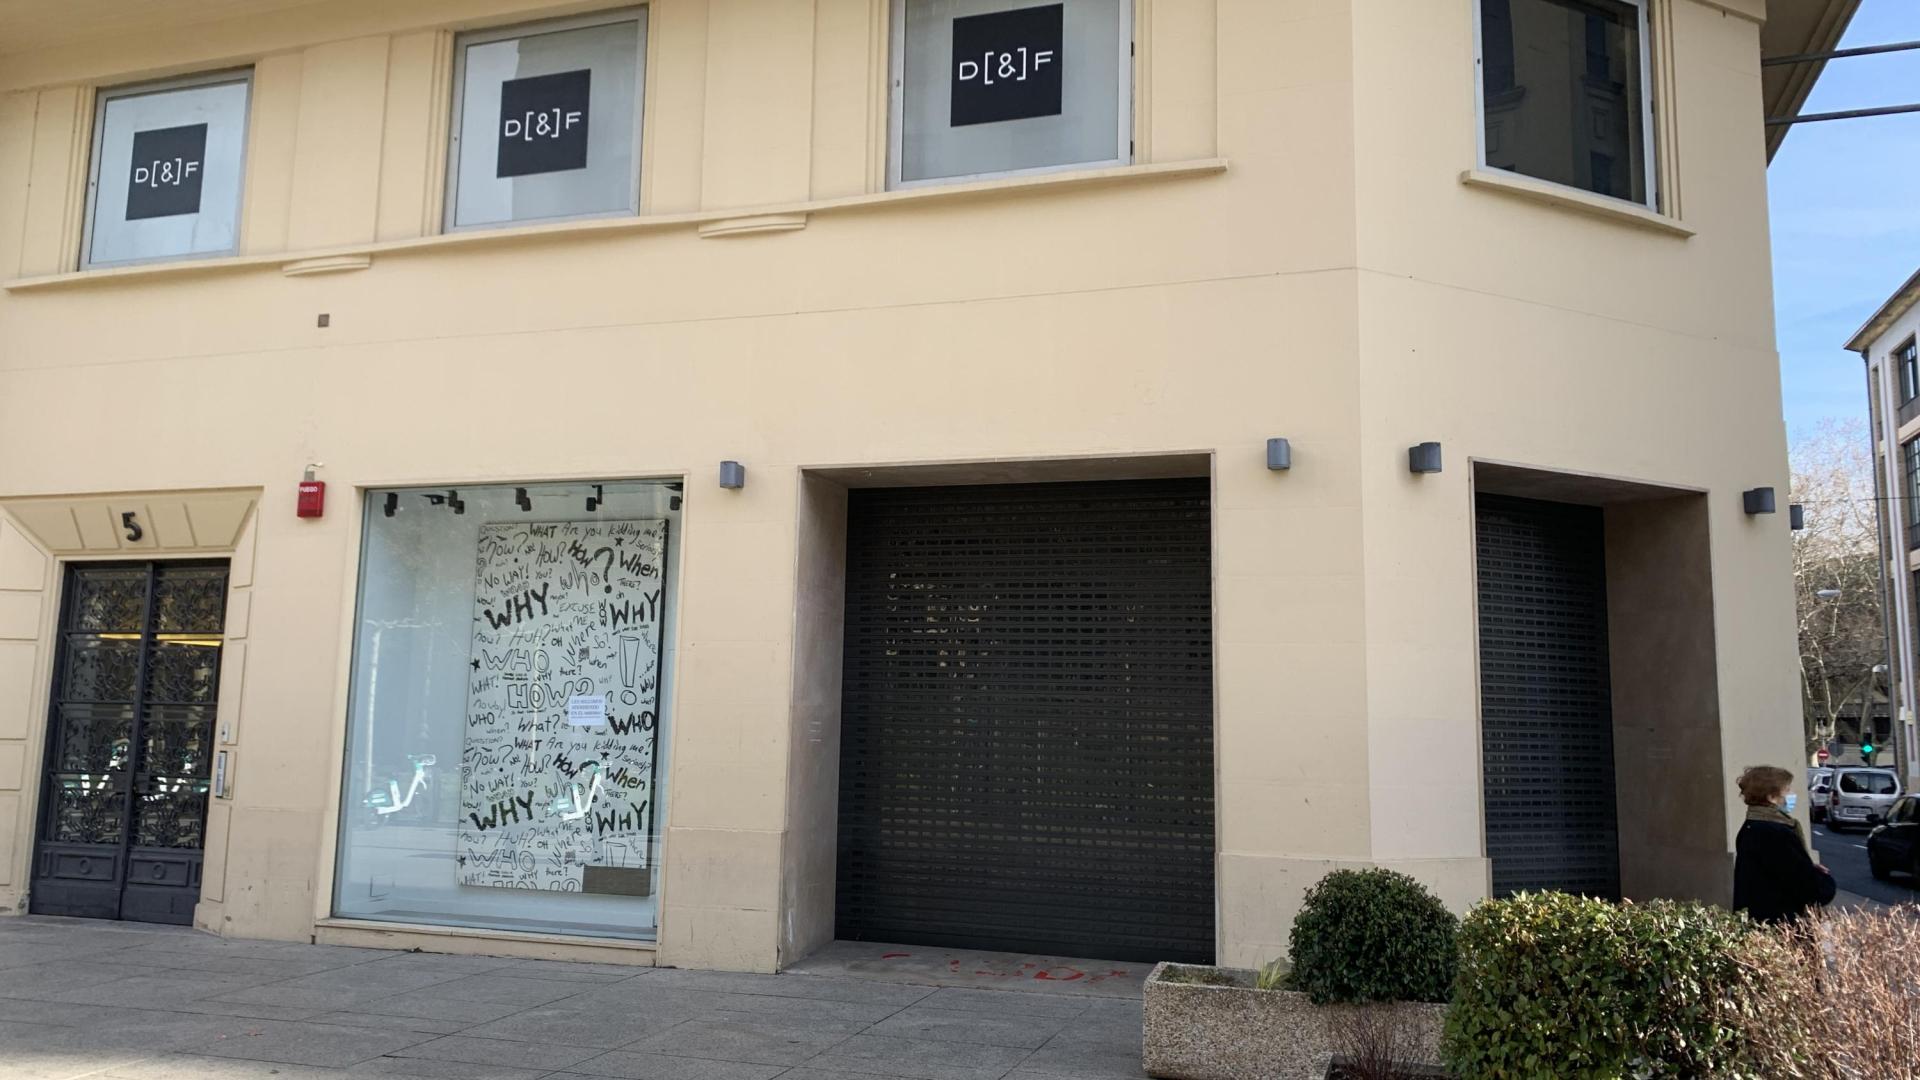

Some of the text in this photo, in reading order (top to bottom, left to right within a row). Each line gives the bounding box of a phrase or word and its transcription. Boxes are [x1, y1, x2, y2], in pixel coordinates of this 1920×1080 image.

[959, 47, 1054, 85] D[&]F
[504, 108, 582, 141] D[&]F
[135, 157, 199, 188] D[&]F
[121, 511, 143, 543] 5
[529, 522, 558, 539] WHAT
[581, 526, 602, 544] you
[608, 522, 641, 545] kidding
[618, 549, 659, 580] When
[483, 581, 550, 631] WHY
[609, 589, 661, 631] WHY
[482, 648, 550, 673] WHO
[468, 711, 495, 728] WHO
[607, 709, 657, 736] WHO
[567, 742, 587, 756] you
[593, 737, 626, 760] kidding
[605, 766, 646, 793] When
[469, 789, 535, 832] WHY
[594, 799, 649, 838] WHY
[468, 847, 536, 873] WHO
